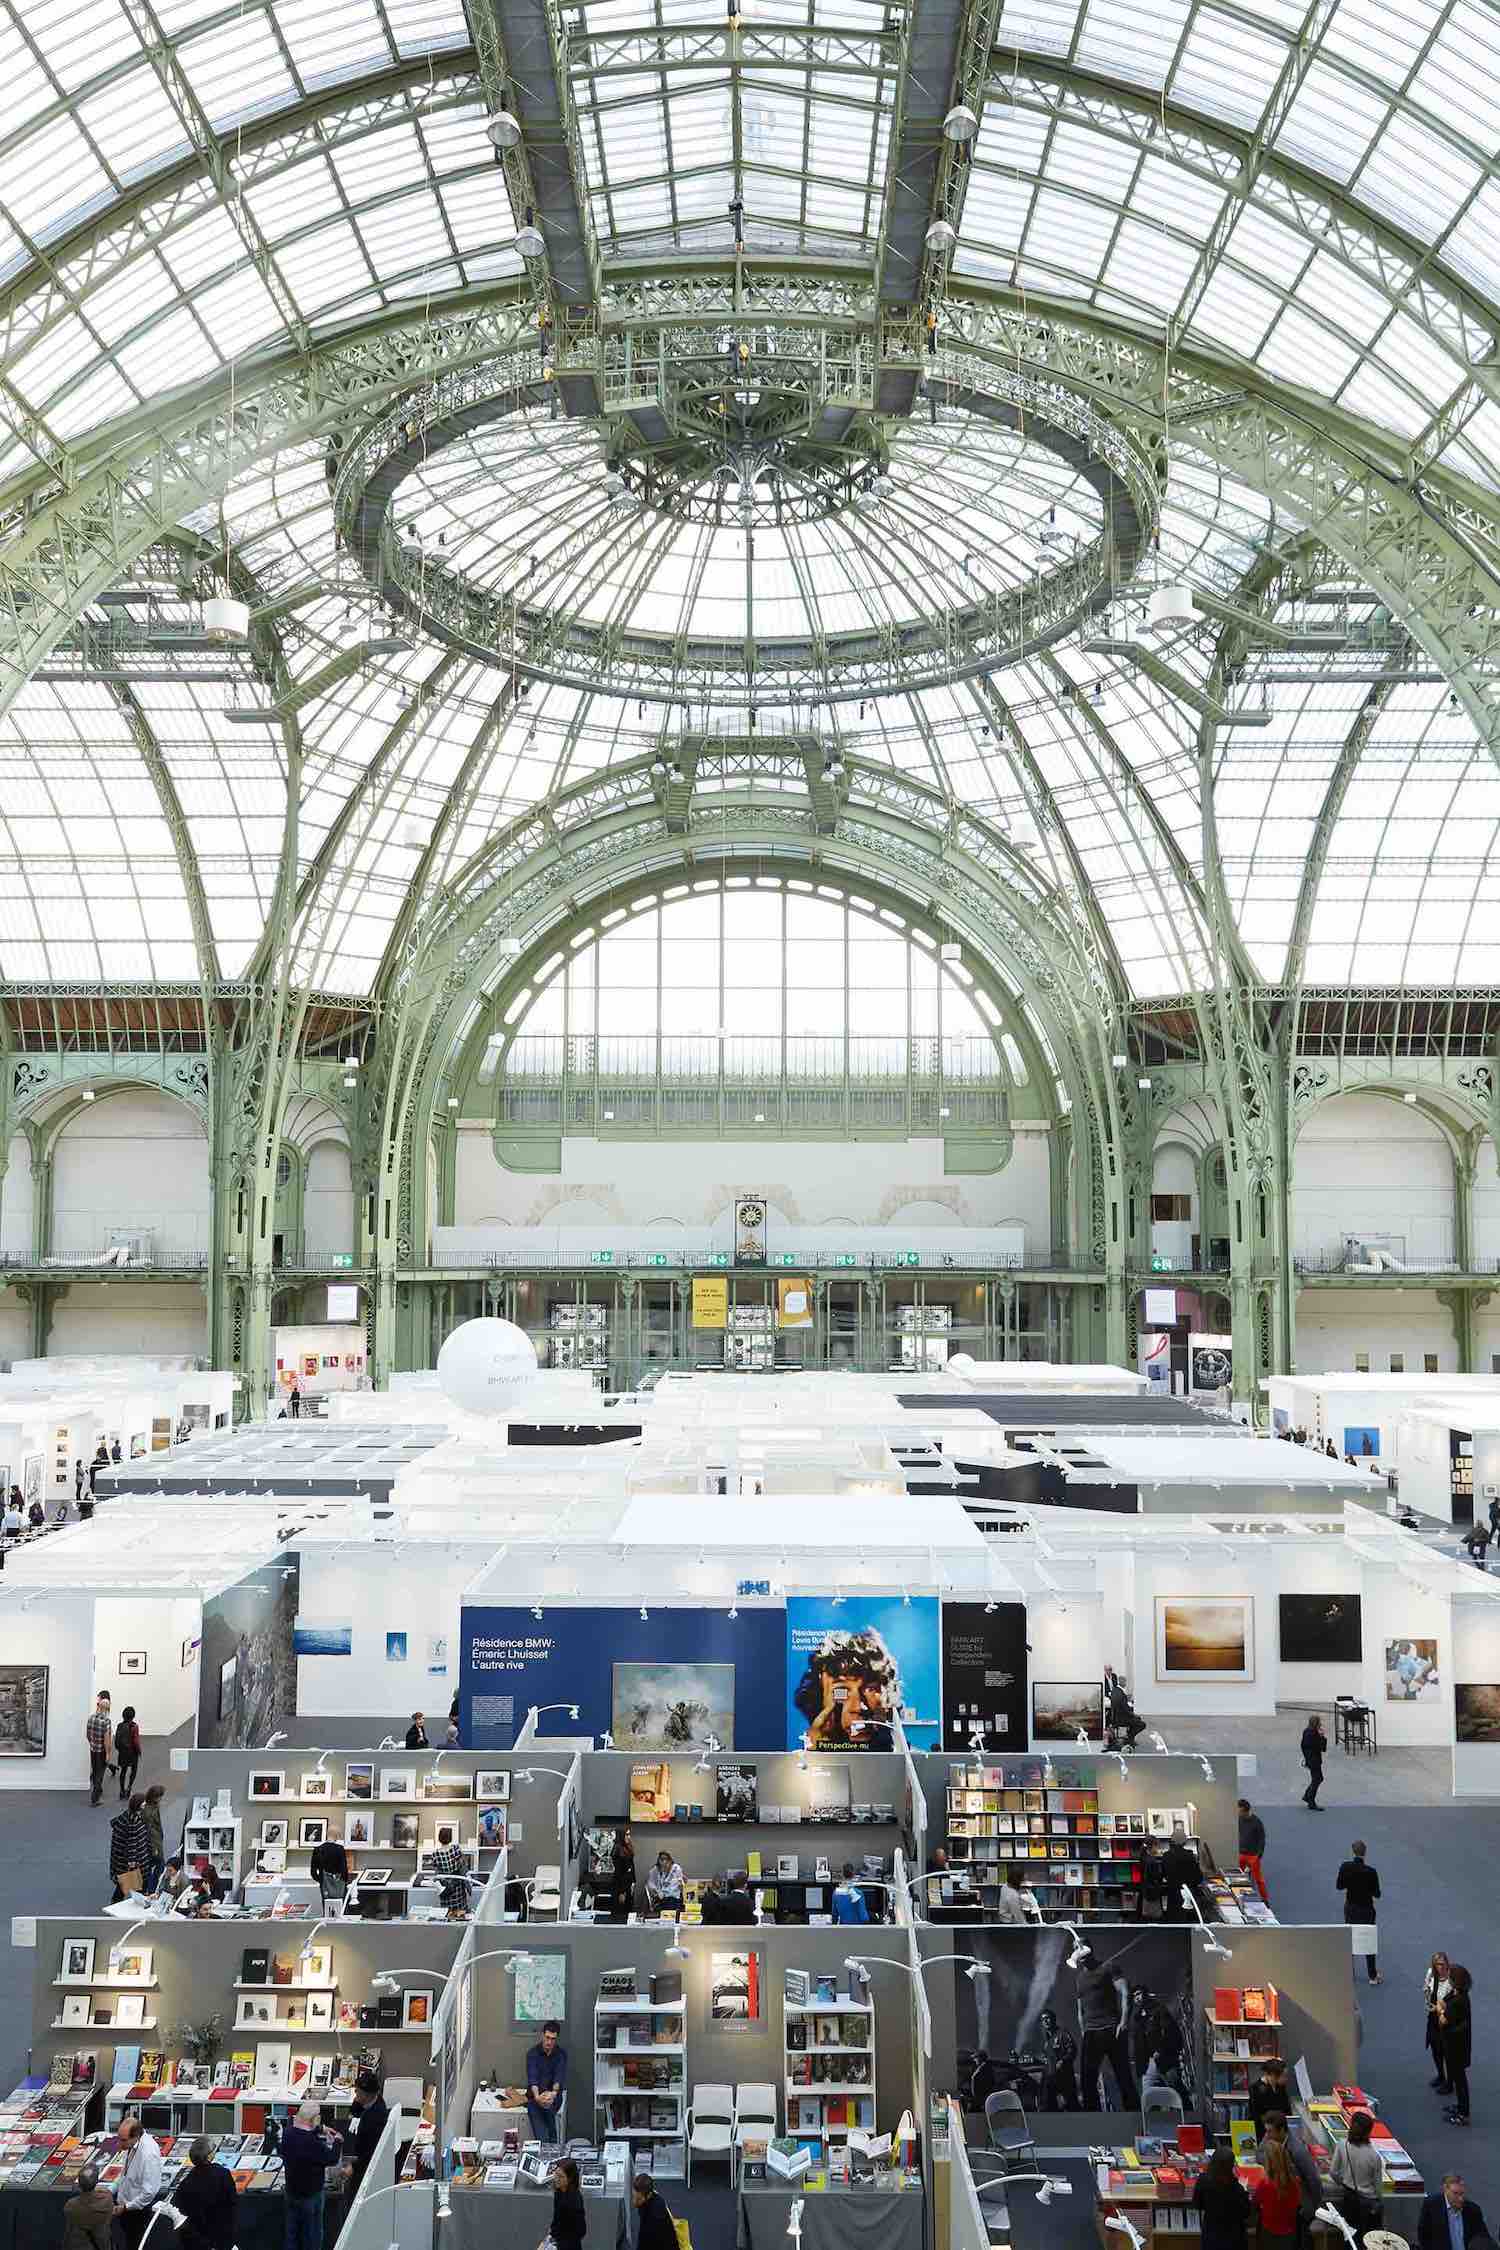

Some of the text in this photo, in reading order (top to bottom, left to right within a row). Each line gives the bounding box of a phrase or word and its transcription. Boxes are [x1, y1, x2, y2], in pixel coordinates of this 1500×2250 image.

[472, 1638, 556, 1648] Résidence BMW:
[508, 1649, 548, 1659] Lhuisset
[472, 1660, 525, 1670] L'autre rive
[820, 1742, 858, 1751] Perspective
[602, 1975, 633, 1985] CHAOS
